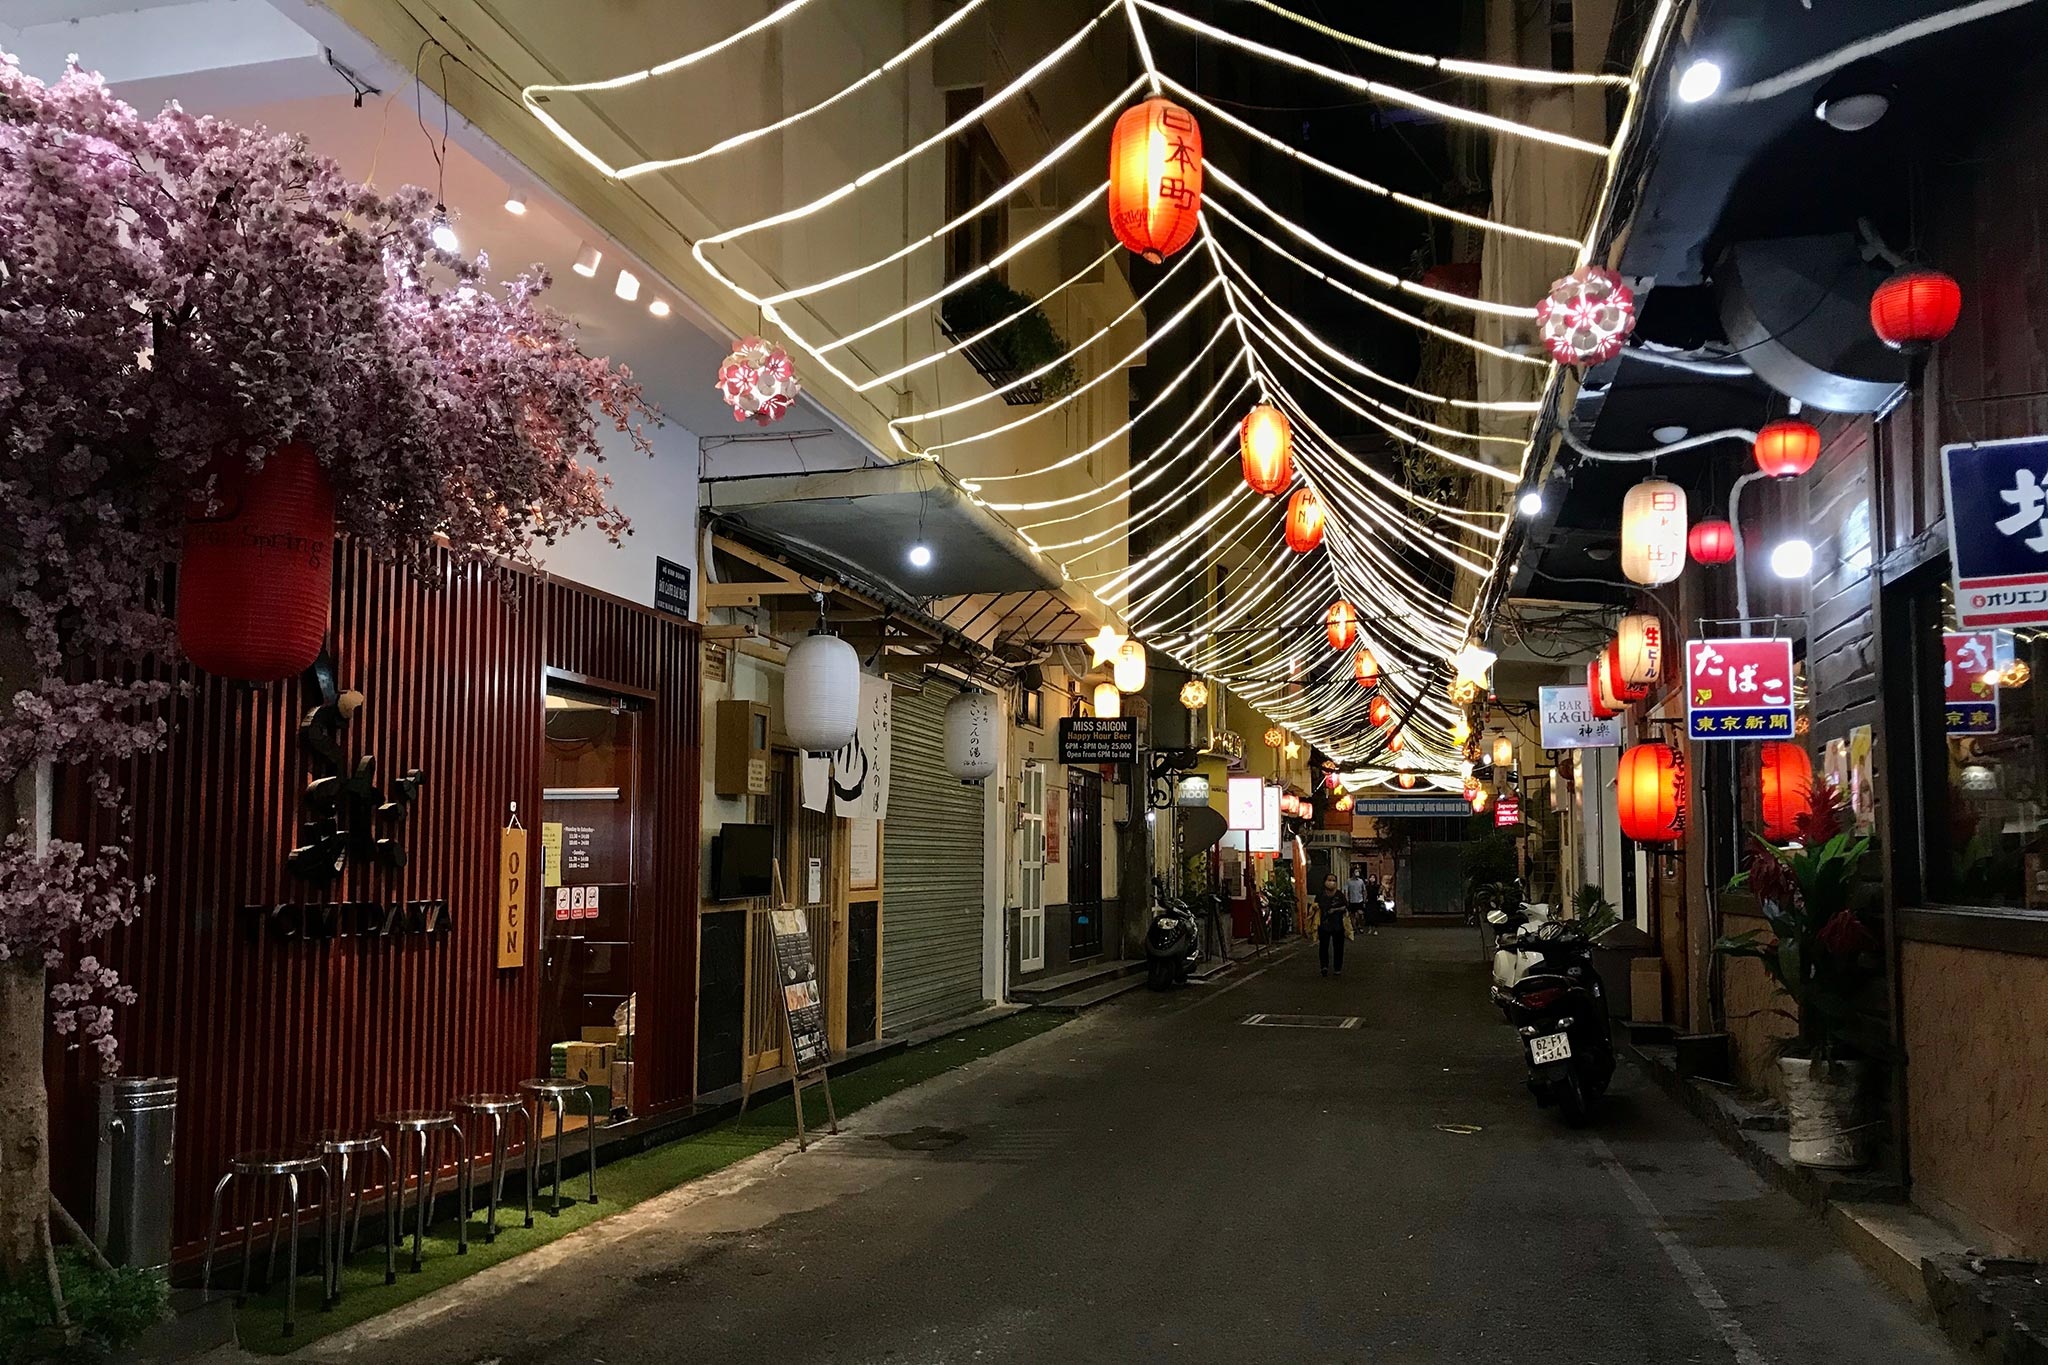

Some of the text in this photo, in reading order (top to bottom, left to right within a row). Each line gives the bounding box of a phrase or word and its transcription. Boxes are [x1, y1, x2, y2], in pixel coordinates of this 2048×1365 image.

[1160, 106, 1197, 210] 日本町
[1648, 491, 1679, 568] 日町
[1645, 627, 1659, 678] 生ビール
[1695, 644, 1786, 704] たばこ
[1558, 700, 1582, 711] BAR
[1072, 721, 1127, 732] MISS SAIGON
[1694, 714, 1788, 732] 東京新聞
[1067, 731, 1132, 741] Happy Hour Beer
[1097, 743, 1110, 751] Only
[1066, 751, 1082, 759] Open
[1179, 790, 1209, 799] MOON
[507, 852, 519, 953] OPEN
[1536, 1035, 1562, 1050] 62-F1
